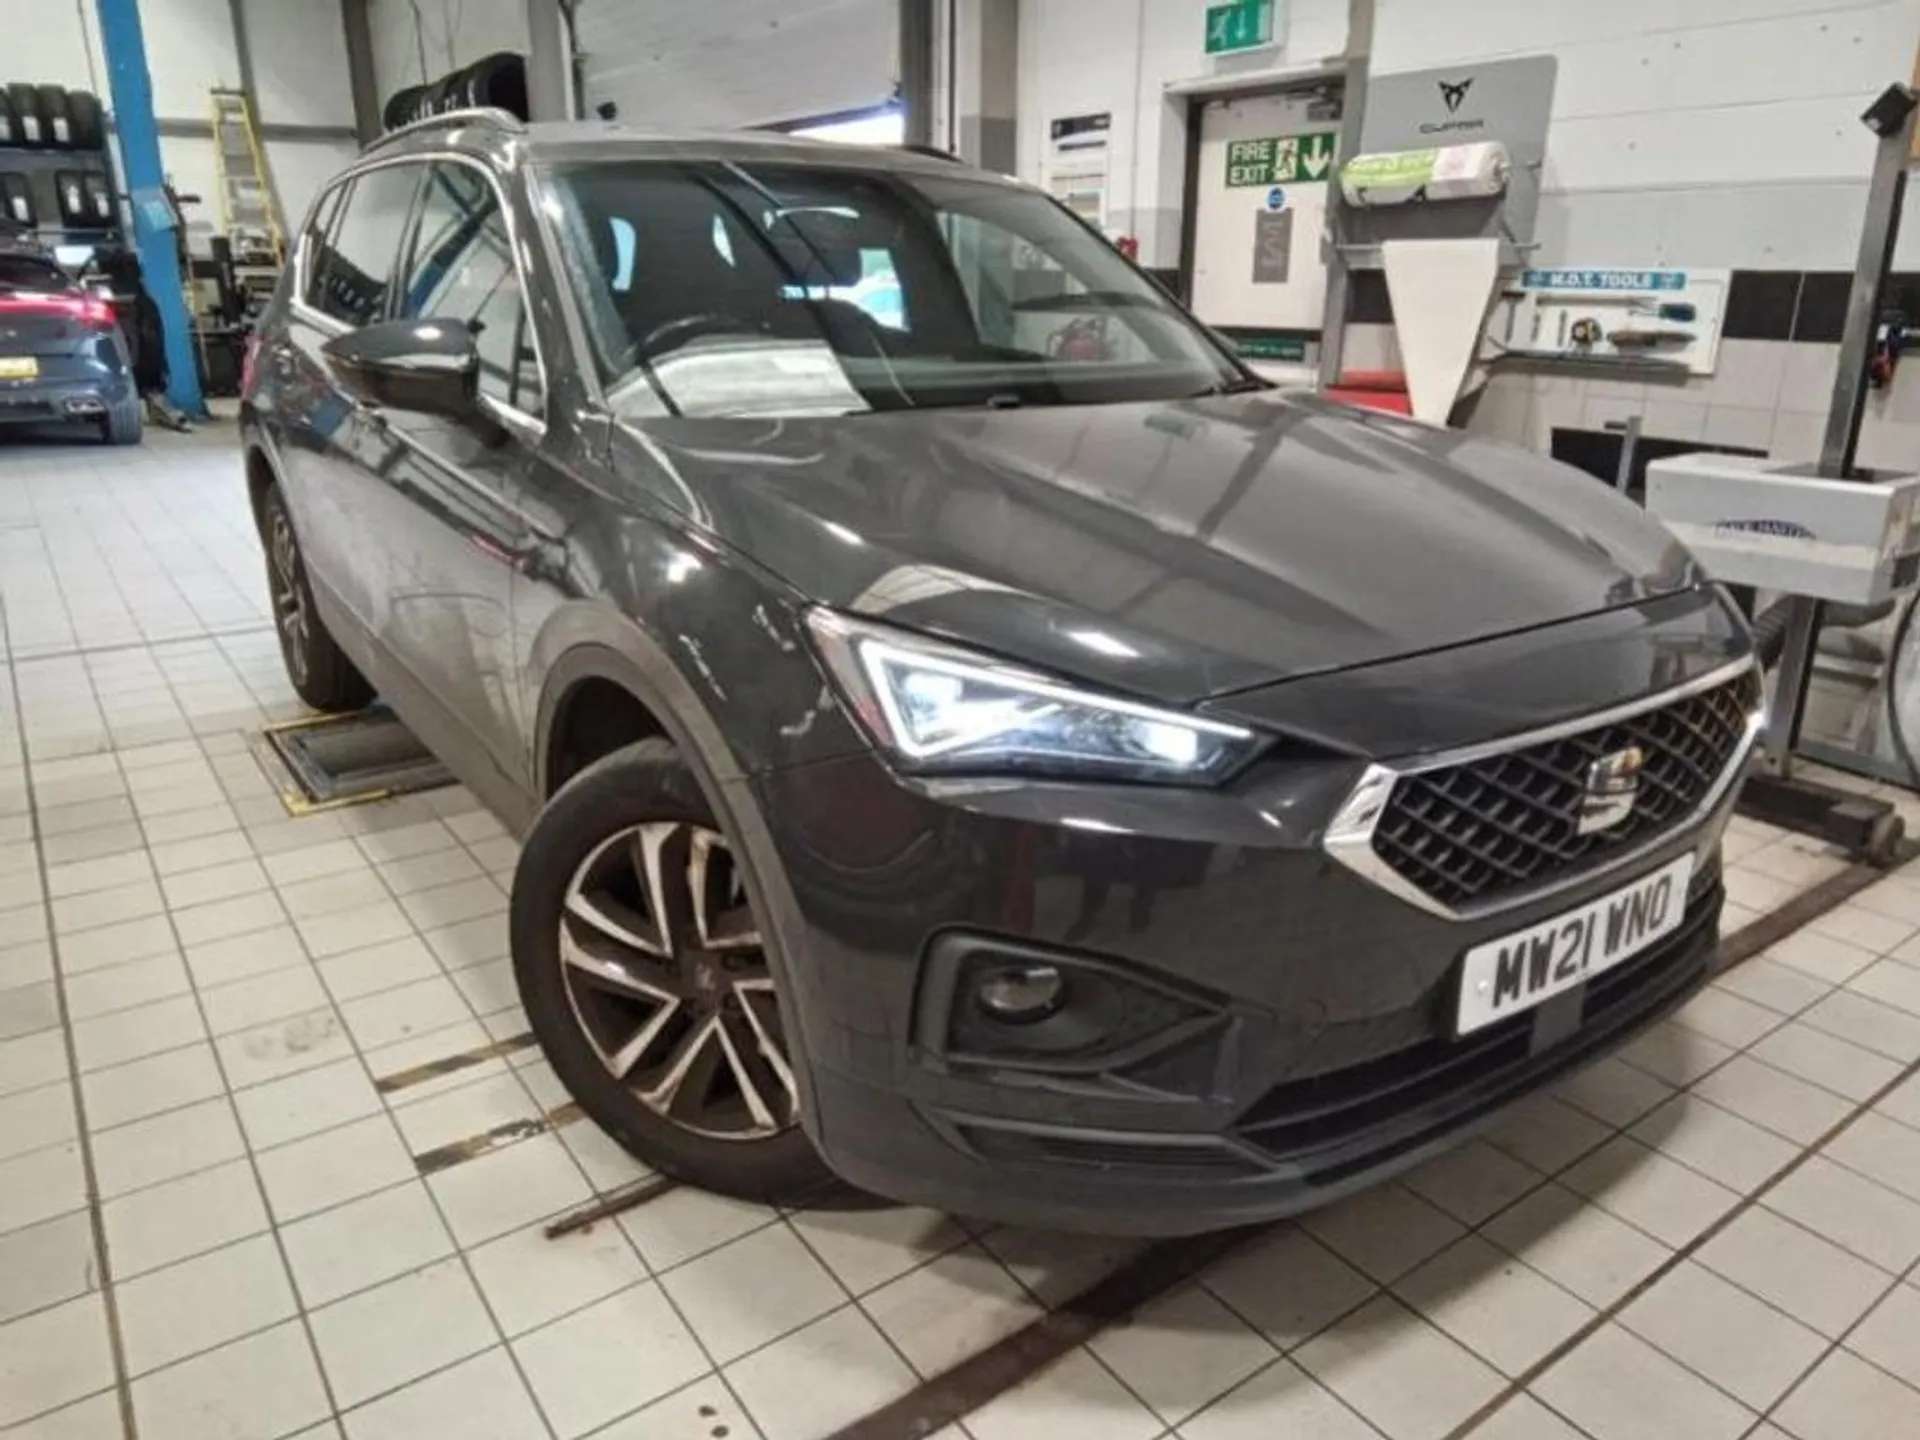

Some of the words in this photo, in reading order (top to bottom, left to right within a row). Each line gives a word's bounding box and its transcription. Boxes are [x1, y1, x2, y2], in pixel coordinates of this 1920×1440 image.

[1232, 140, 1270, 161] FIRE
[1231, 164, 1269, 184] EXIT
[1599, 272, 1651, 286] TOOLS
[1493, 911, 1597, 1008] MW21
[1604, 875, 1672, 957] WNO
